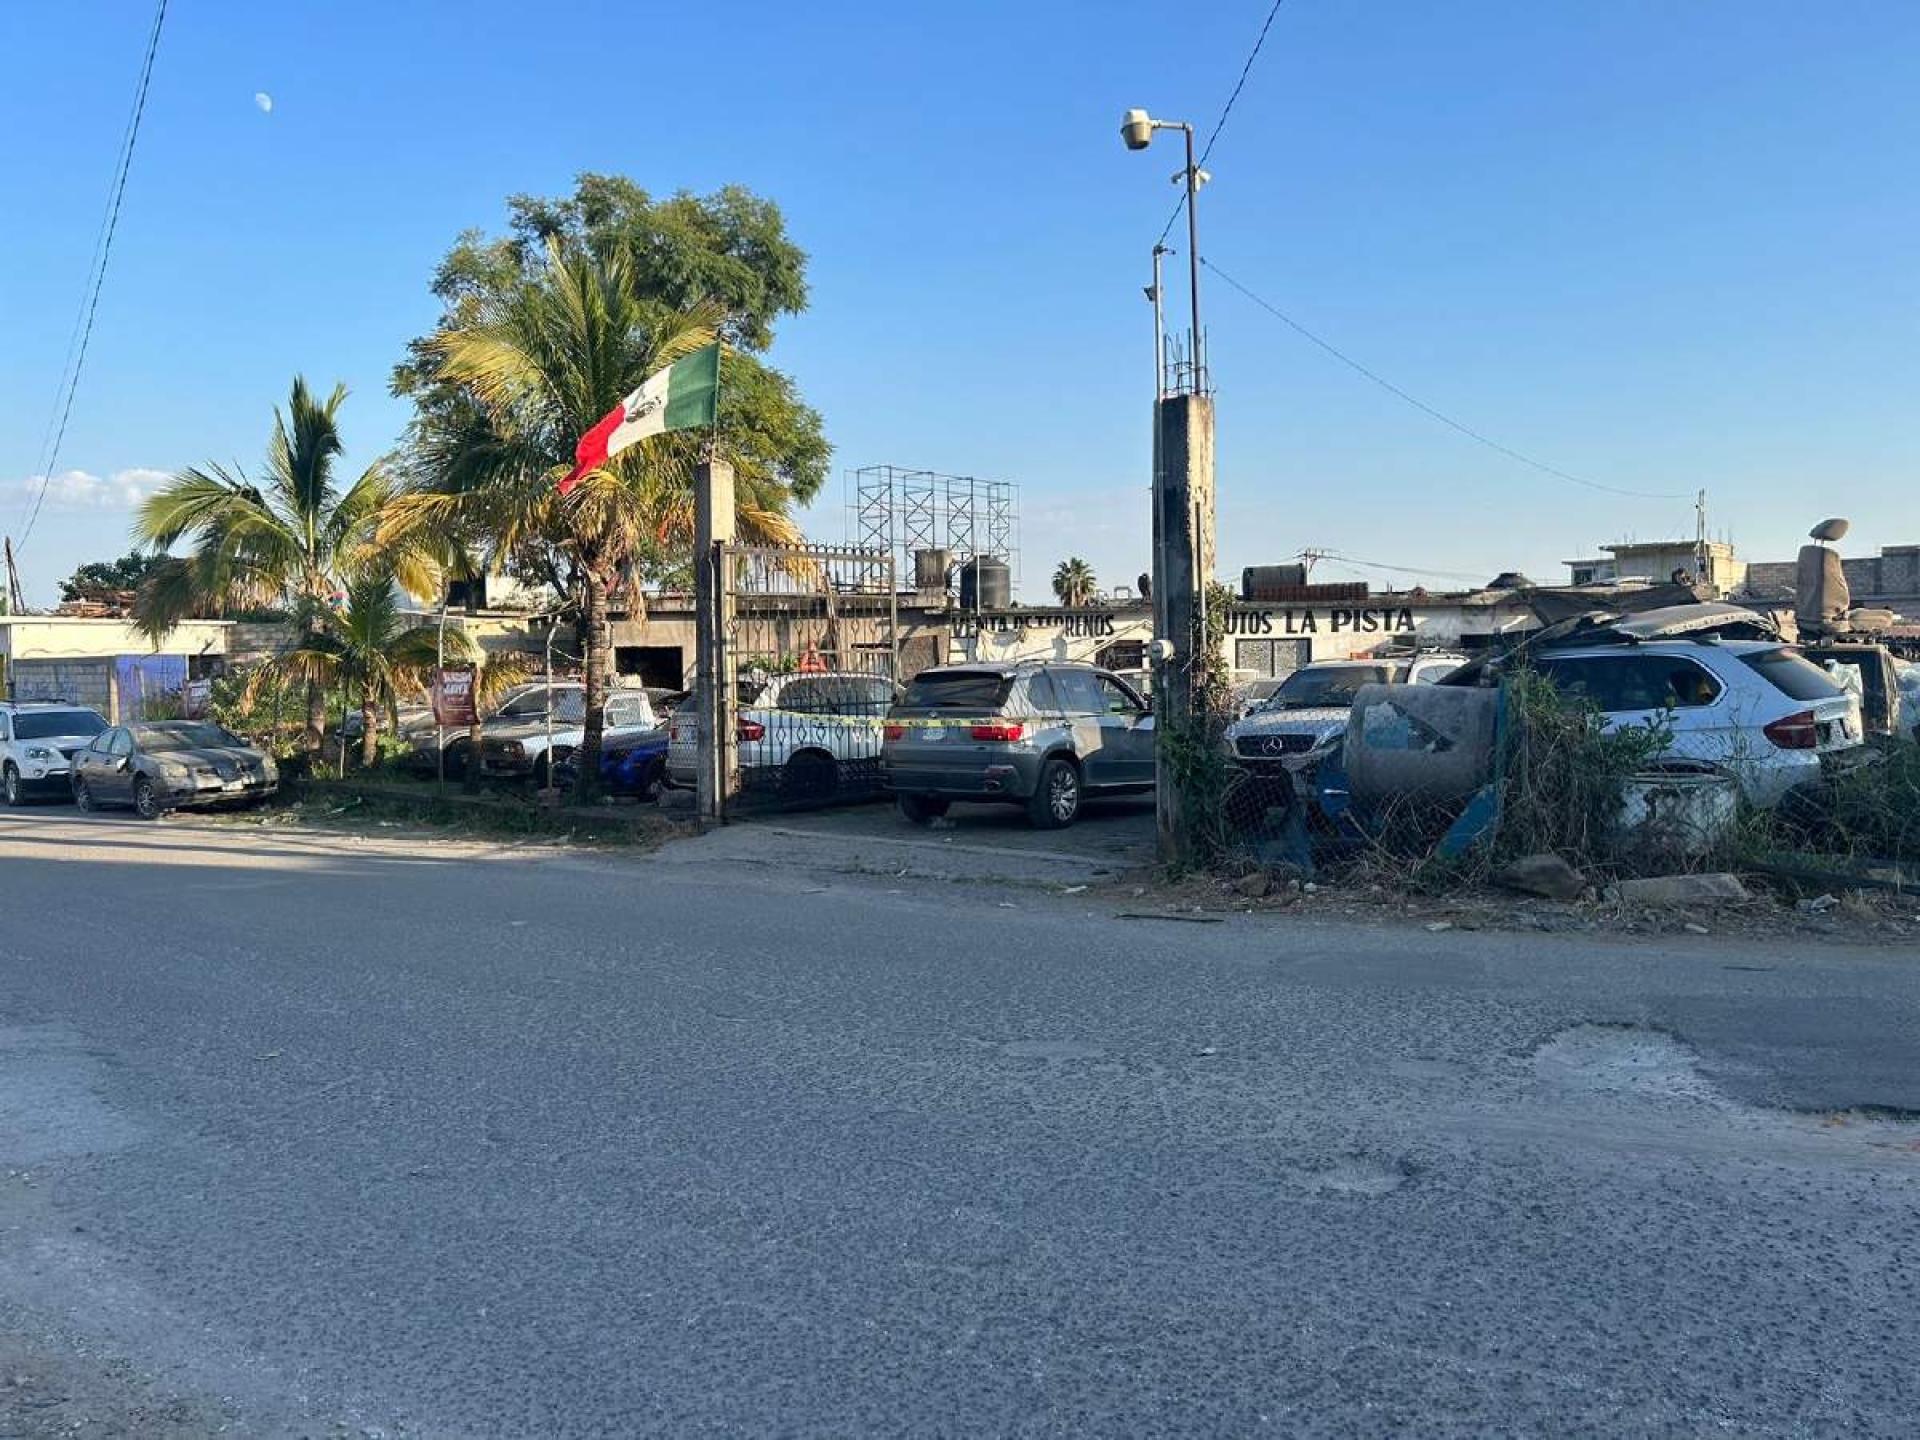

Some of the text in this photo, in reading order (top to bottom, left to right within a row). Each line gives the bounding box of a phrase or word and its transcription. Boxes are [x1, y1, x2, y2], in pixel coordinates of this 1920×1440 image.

[1223, 608, 1416, 634] UTOS LA PISTA
